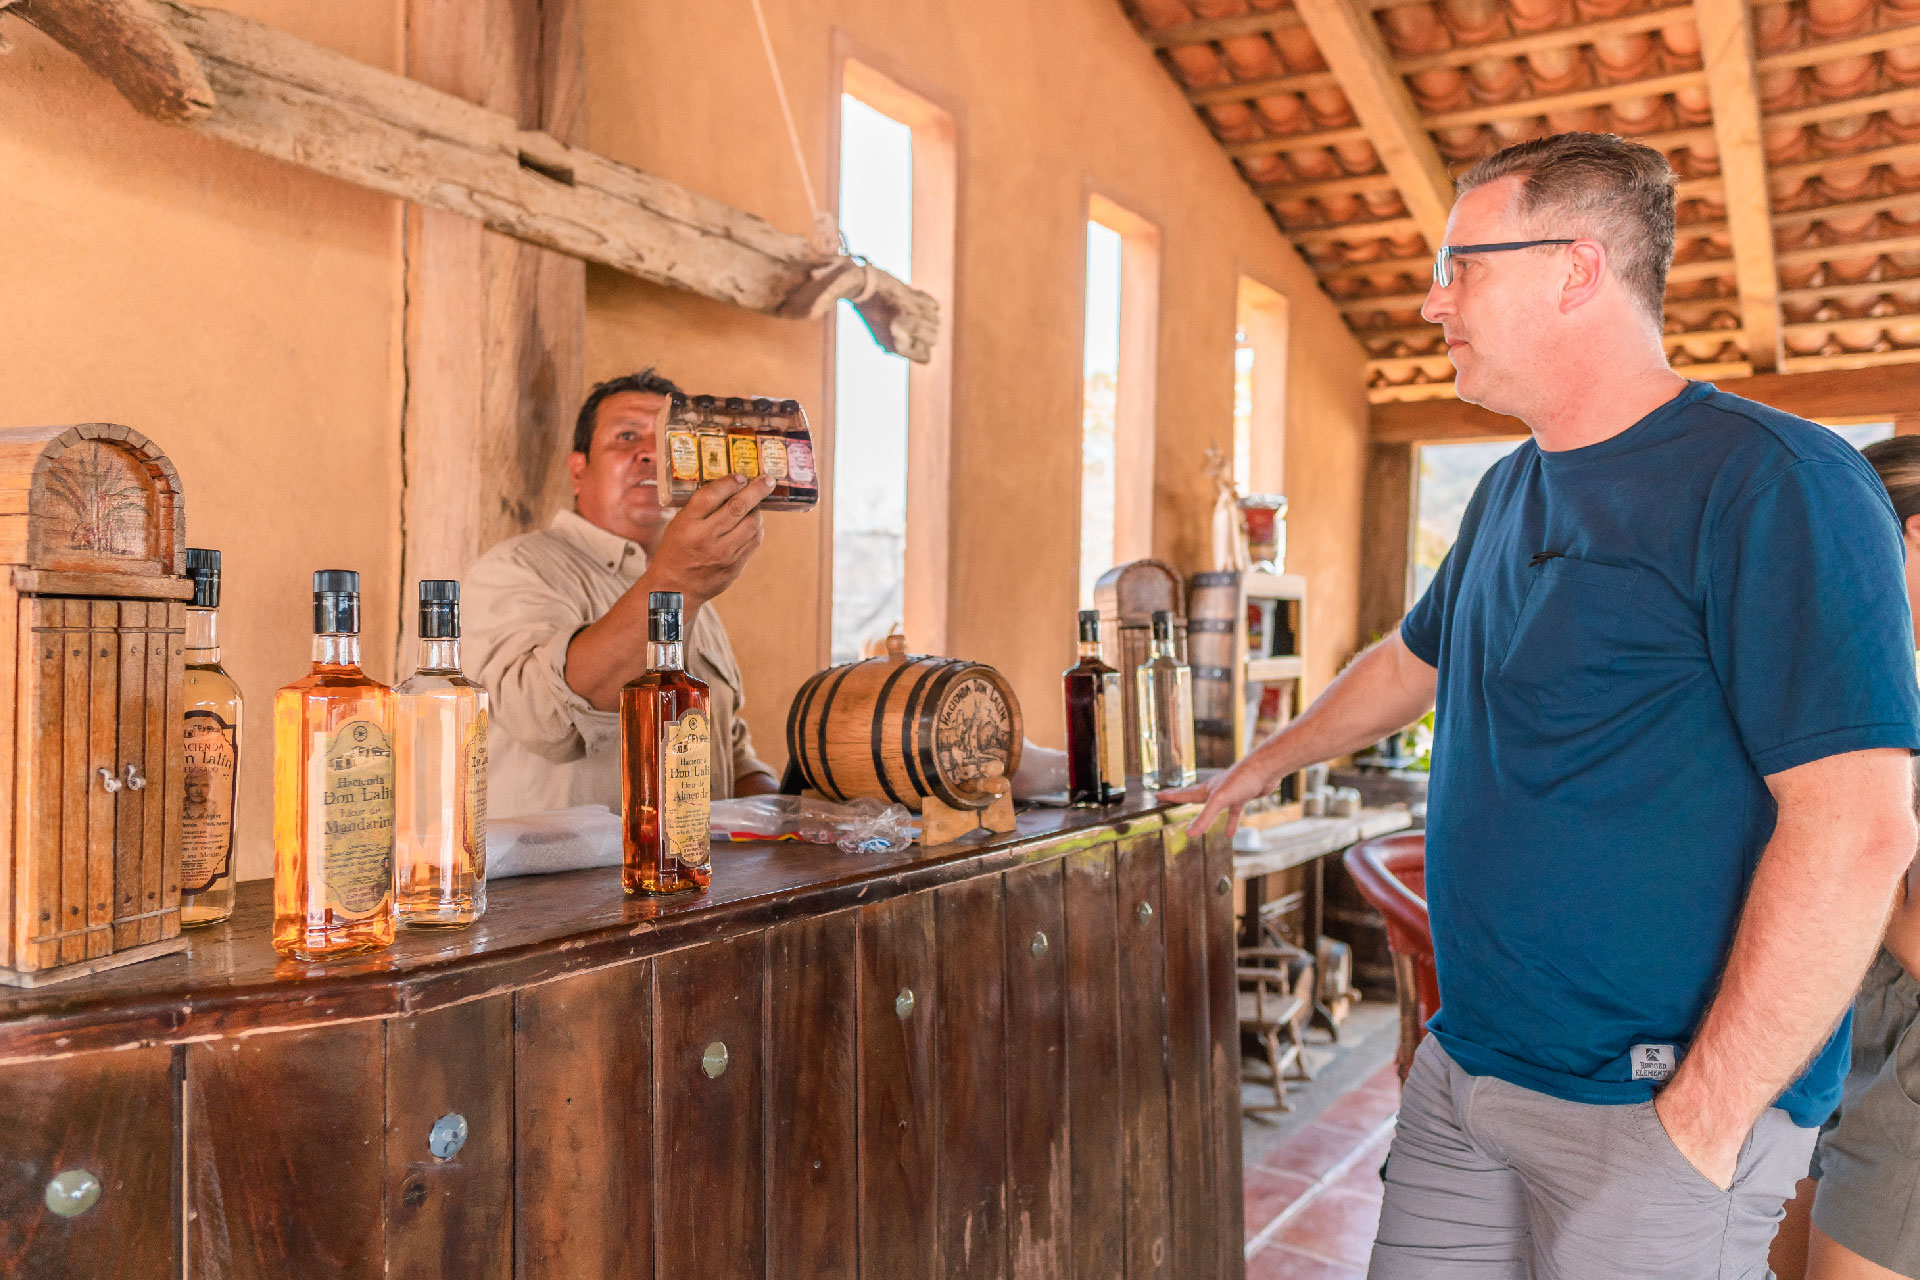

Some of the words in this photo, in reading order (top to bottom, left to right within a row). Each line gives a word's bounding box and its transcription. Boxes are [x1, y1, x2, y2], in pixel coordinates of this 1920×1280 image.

[939, 684, 971, 726] HACIENDA
[183, 743, 224, 751] ACIENDA
[694, 765, 709, 777] Lali
[336, 775, 385, 788] Hacienda
[322, 791, 354, 805] Don
[673, 787, 709, 802] Almendr
[1640, 1061, 1667, 1070] RUGGED
